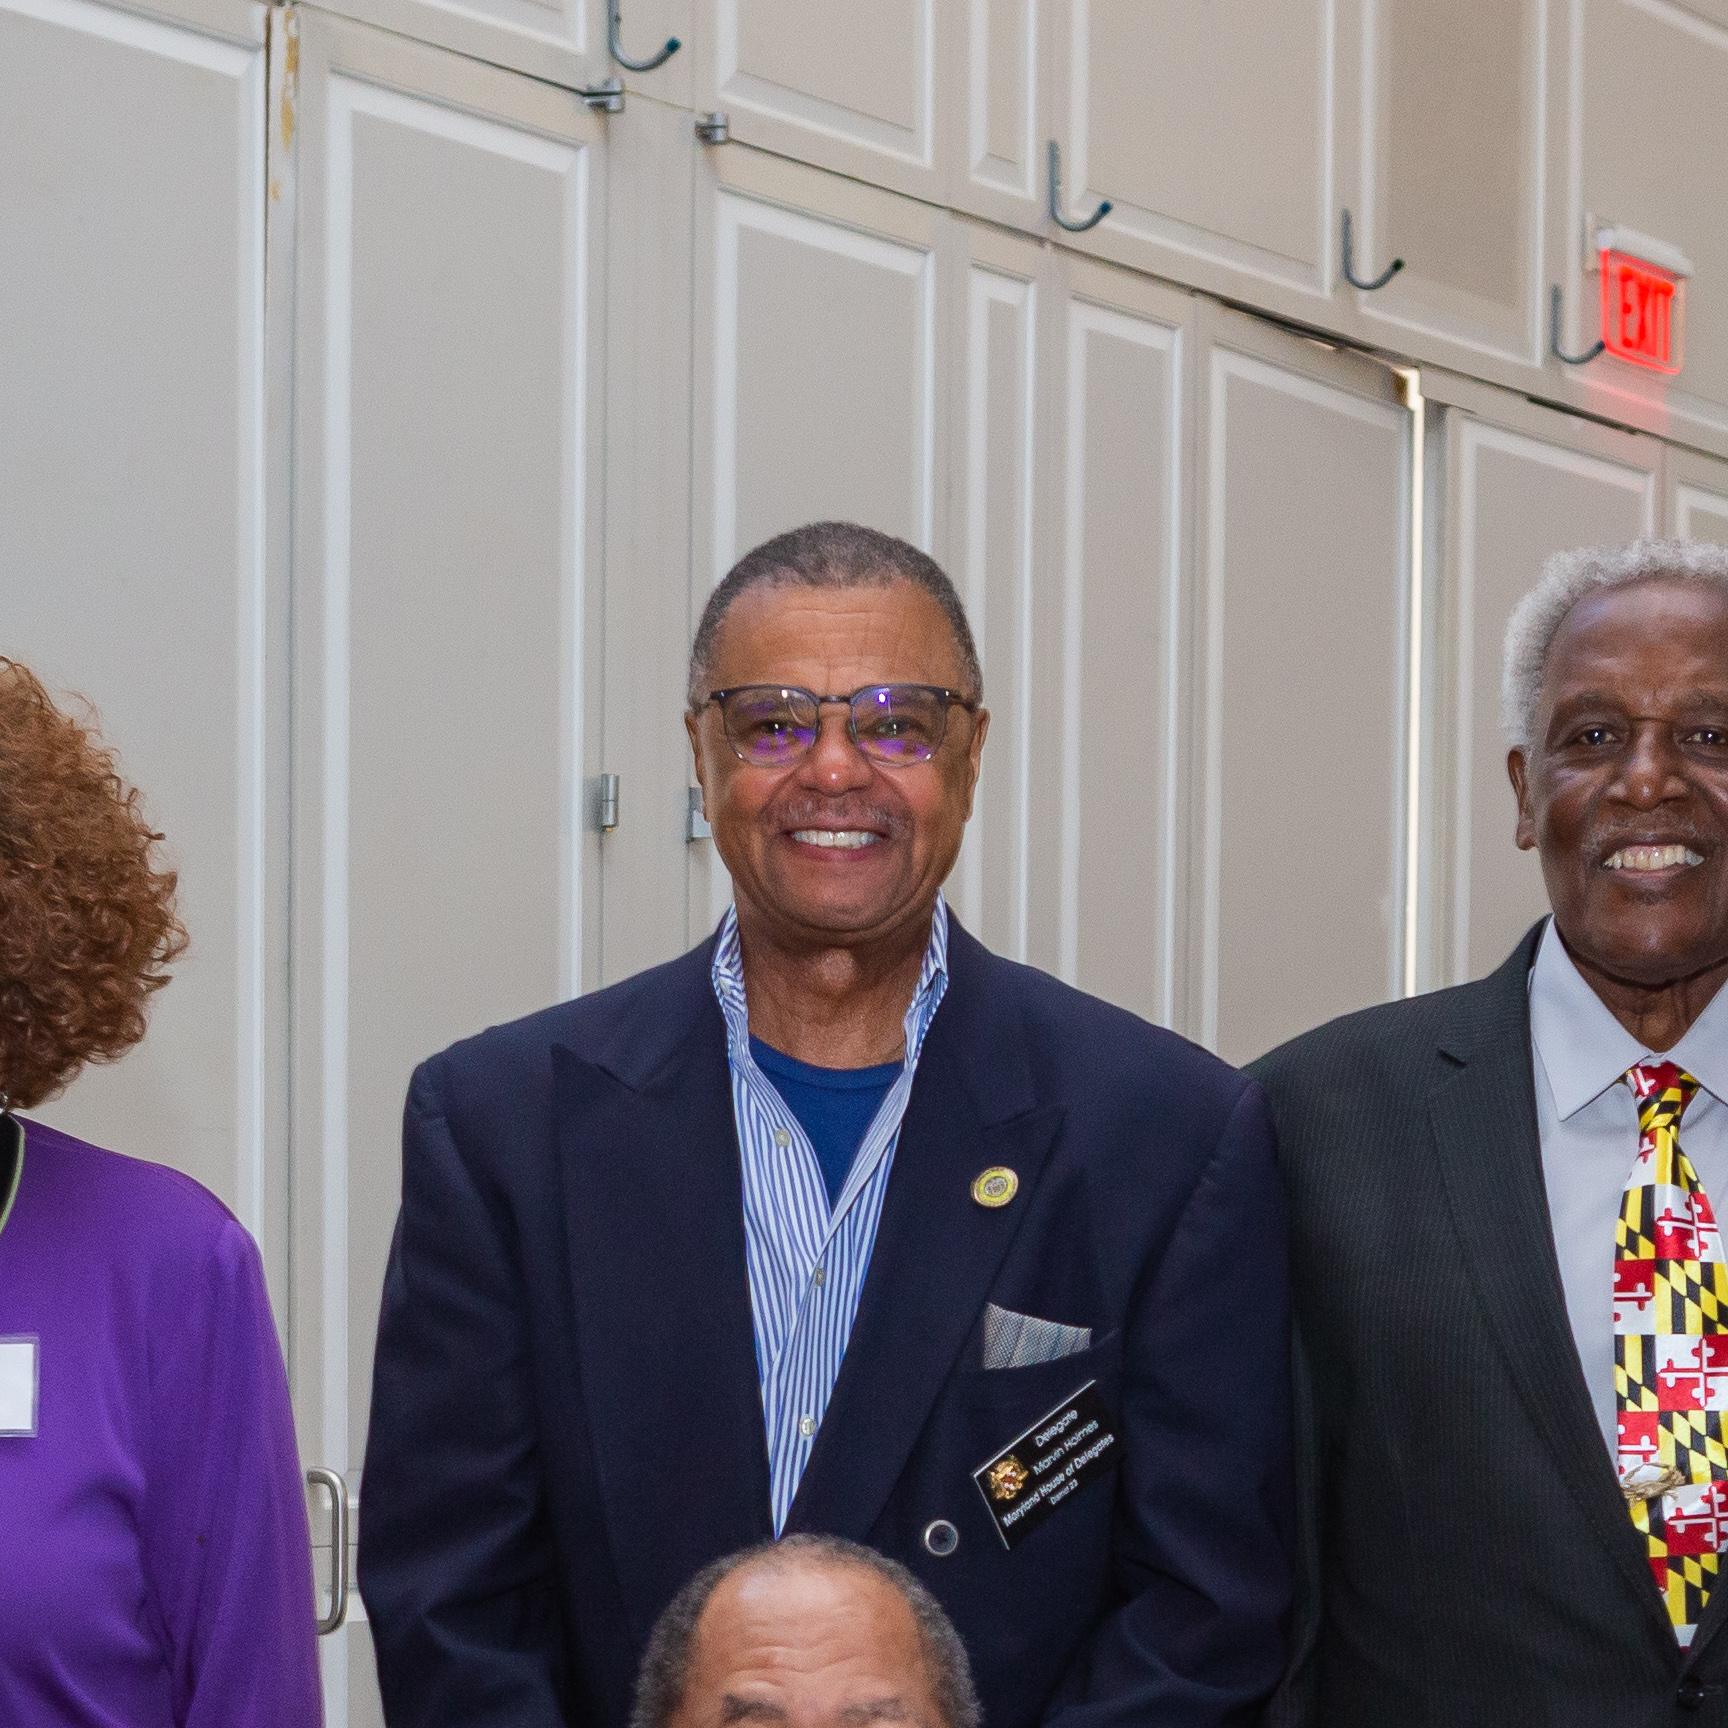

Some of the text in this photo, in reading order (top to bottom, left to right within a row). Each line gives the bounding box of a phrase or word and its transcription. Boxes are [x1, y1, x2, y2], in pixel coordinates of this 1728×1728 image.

[1619, 265, 1675, 362] EXIT
[1035, 1409, 1078, 1447] Delegate
[1002, 1433, 1115, 1527] Maryland House of Delegates
